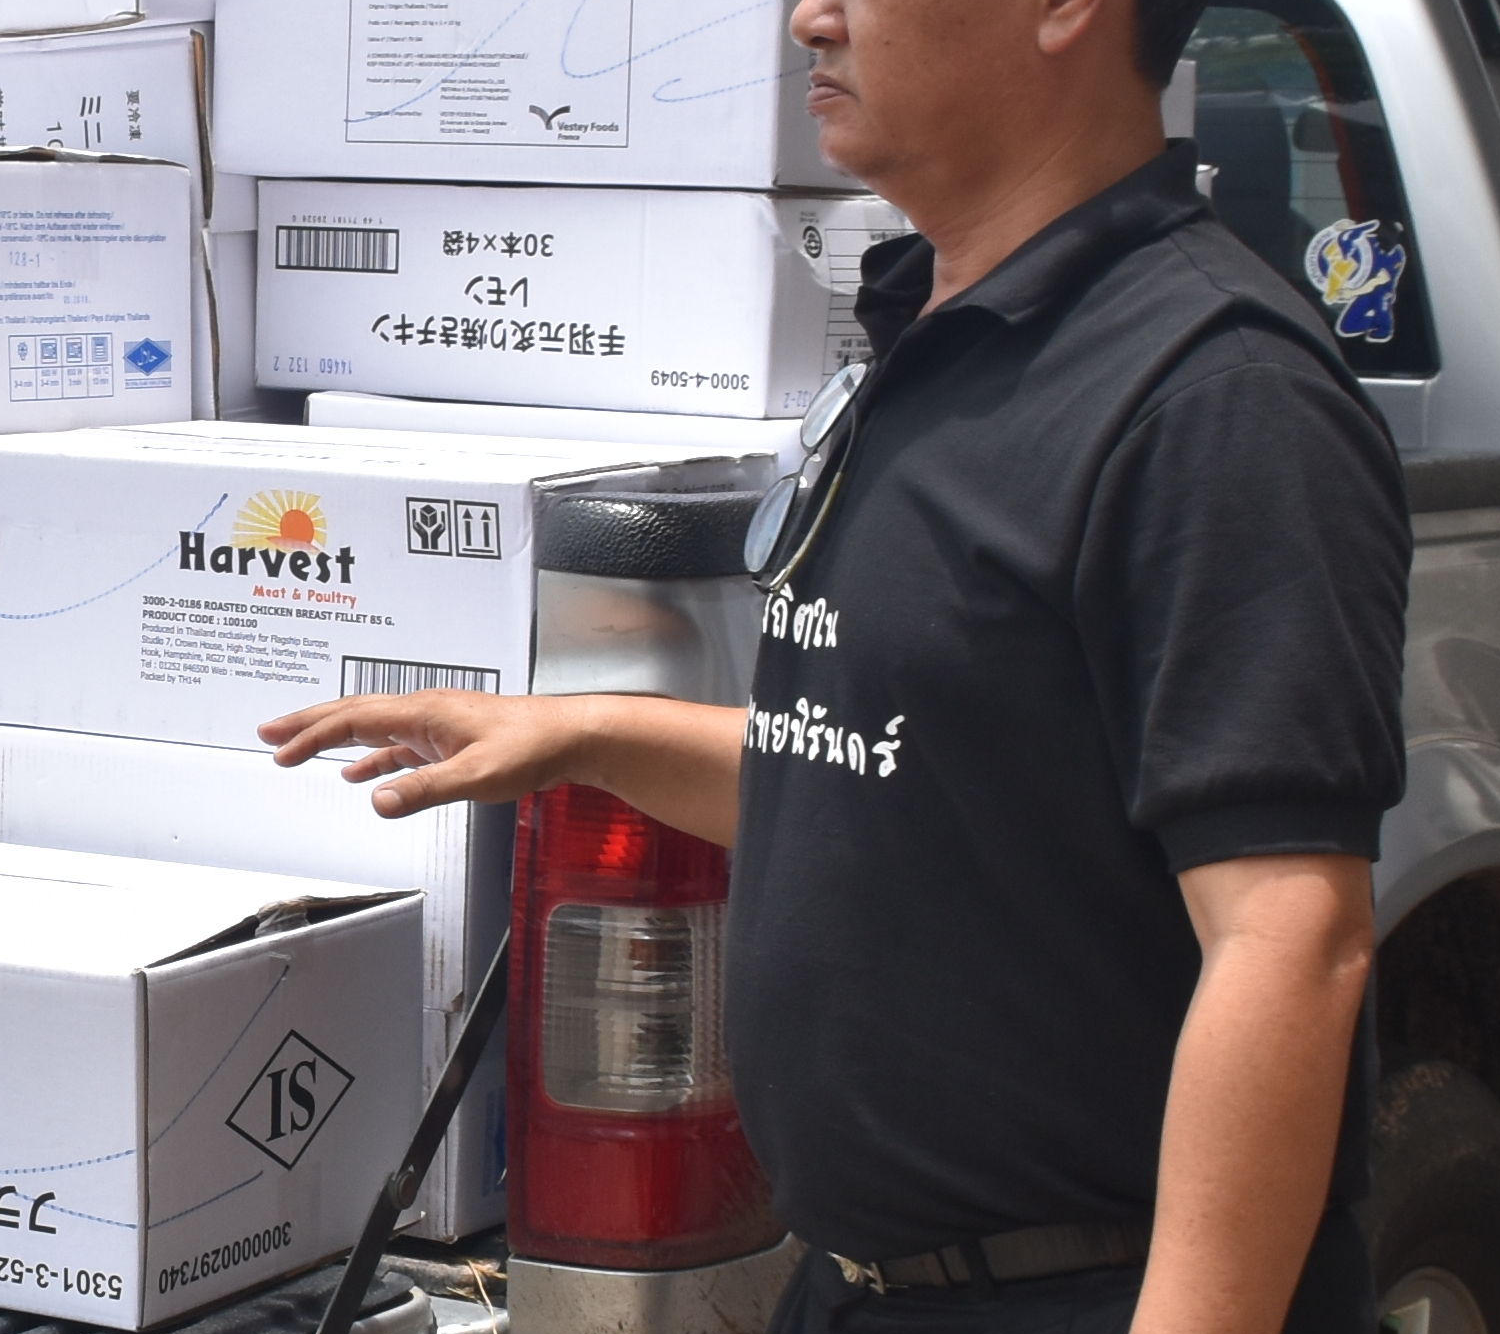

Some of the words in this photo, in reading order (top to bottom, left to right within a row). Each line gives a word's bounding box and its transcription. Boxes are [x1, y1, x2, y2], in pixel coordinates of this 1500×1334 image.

[126, 89, 141, 141] 要冷凍
[557, 121, 588, 136] Vestey
[590, 121, 620, 134] Foods
[464, 275, 530, 308] レモン
[273, 356, 279, 371] 2
[289, 357, 308, 373] 132
[319, 358, 352, 375] 14460
[651, 370, 750, 390] 3000-4-5049
[178, 530, 357, 585] Harvest
[252, 584, 287, 601] Meat
[292, 587, 302, 600] &
[307, 590, 358, 609] Poultry
[142, 609, 187, 622] PRODUCT
[188, 613, 214, 625] CODE
[223, 617, 258, 628] 100100
[143, 595, 202, 609] 3000-2-0186
[204, 600, 248, 613] ROASTED
[250, 604, 293, 617] CHICKEN
[295, 609, 333, 620] BREAST
[335, 612, 368, 623] FILLET
[370, 615, 382, 625] 85
[384, 616, 395, 626] G.
[141, 635, 164, 645] Studio
[166, 637, 173, 648] 7,
[175, 638, 198, 648] Crown
[199, 641, 224, 652] House,
[226, 643, 243, 654] High
[245, 644, 269, 656] Street,
[271, 647, 298, 659] Hartley
[300, 649, 332, 662] Wintney,
[142, 623, 175, 634] Produced
[177, 626, 184, 634] in
[185, 627, 216, 638] Thailand
[218, 631, 256, 643] exclusively
[258, 633, 269, 642] for
[270, 634, 301, 646] Flagship
[302, 637, 329, 649] Europe
[140, 671, 165, 682] Packed
[167, 673, 176, 684] by
[178, 674, 201, 684] TH144
[157, 1220, 293, 1296] 3000000297340
